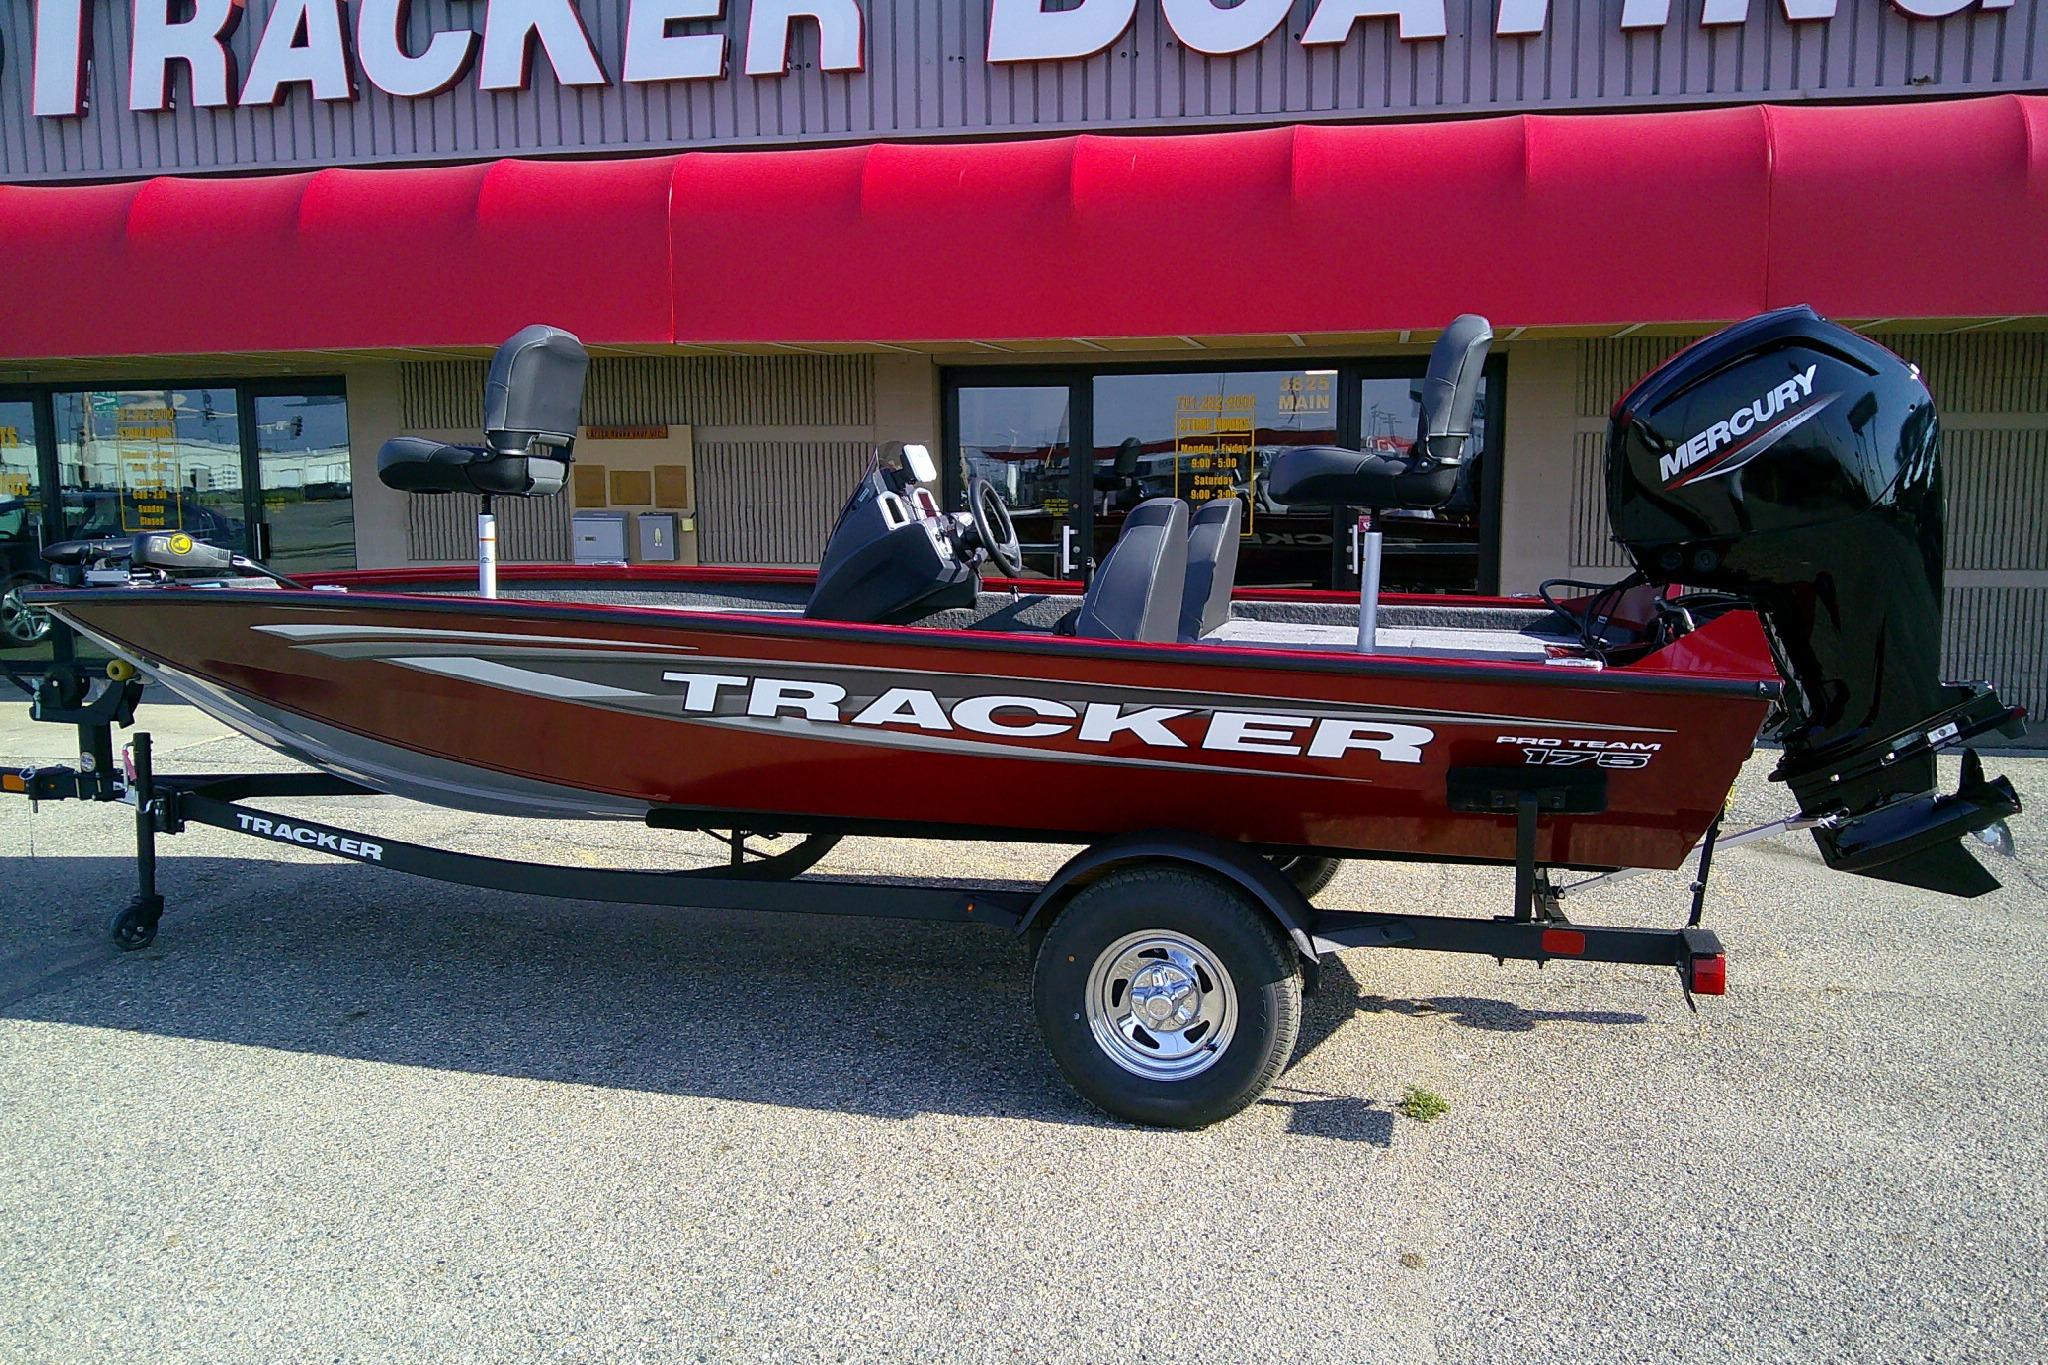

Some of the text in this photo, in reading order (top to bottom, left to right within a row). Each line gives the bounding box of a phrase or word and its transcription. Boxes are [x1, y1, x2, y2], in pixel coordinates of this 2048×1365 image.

[1279, 395, 1329, 410] MAIN
[1659, 364, 1817, 482] MERCURY
[1181, 443, 1214, 454] Monday
[1221, 442, 1248, 455] Friday
[1194, 475, 1233, 486] Saturday
[662, 671, 1436, 763] TRACKER
[1496, 736, 1662, 751] PRO TEAM
[1522, 747, 1652, 769] 175
[236, 813, 384, 861] TRACKER
